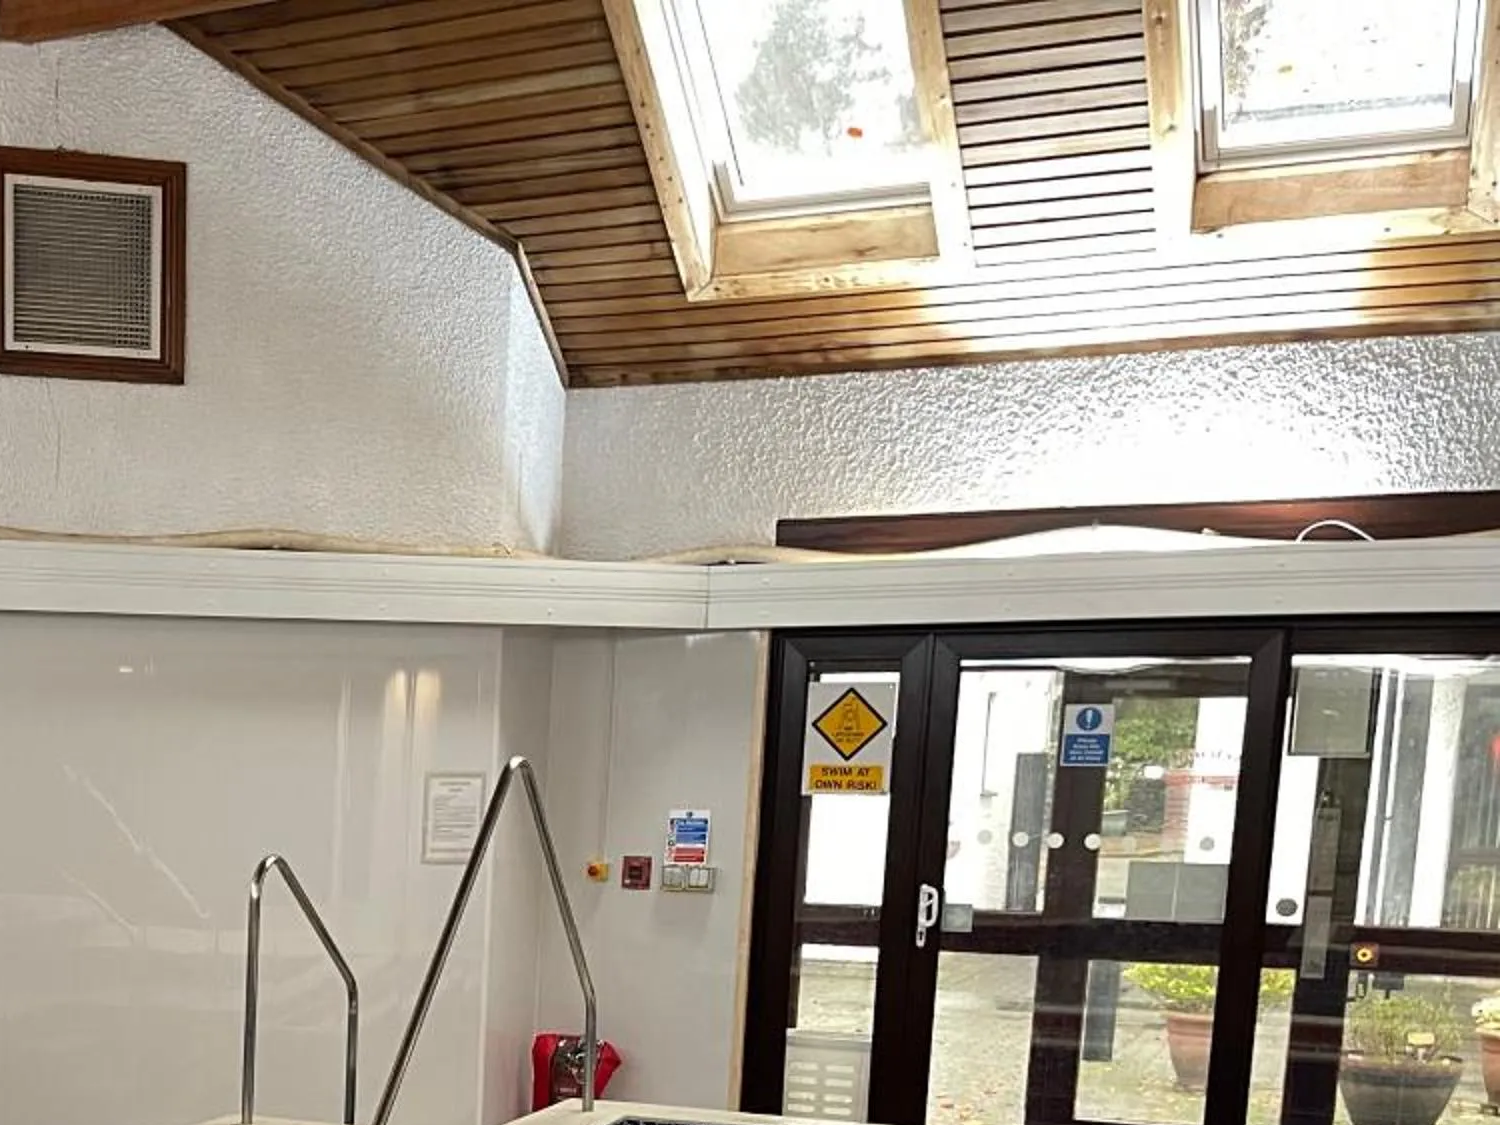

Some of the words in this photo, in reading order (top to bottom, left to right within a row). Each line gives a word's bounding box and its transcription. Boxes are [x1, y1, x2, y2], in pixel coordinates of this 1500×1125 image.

[821, 767, 853, 777] SWIM
[857, 767, 870, 777] AT
[815, 779, 842, 789] OWN
